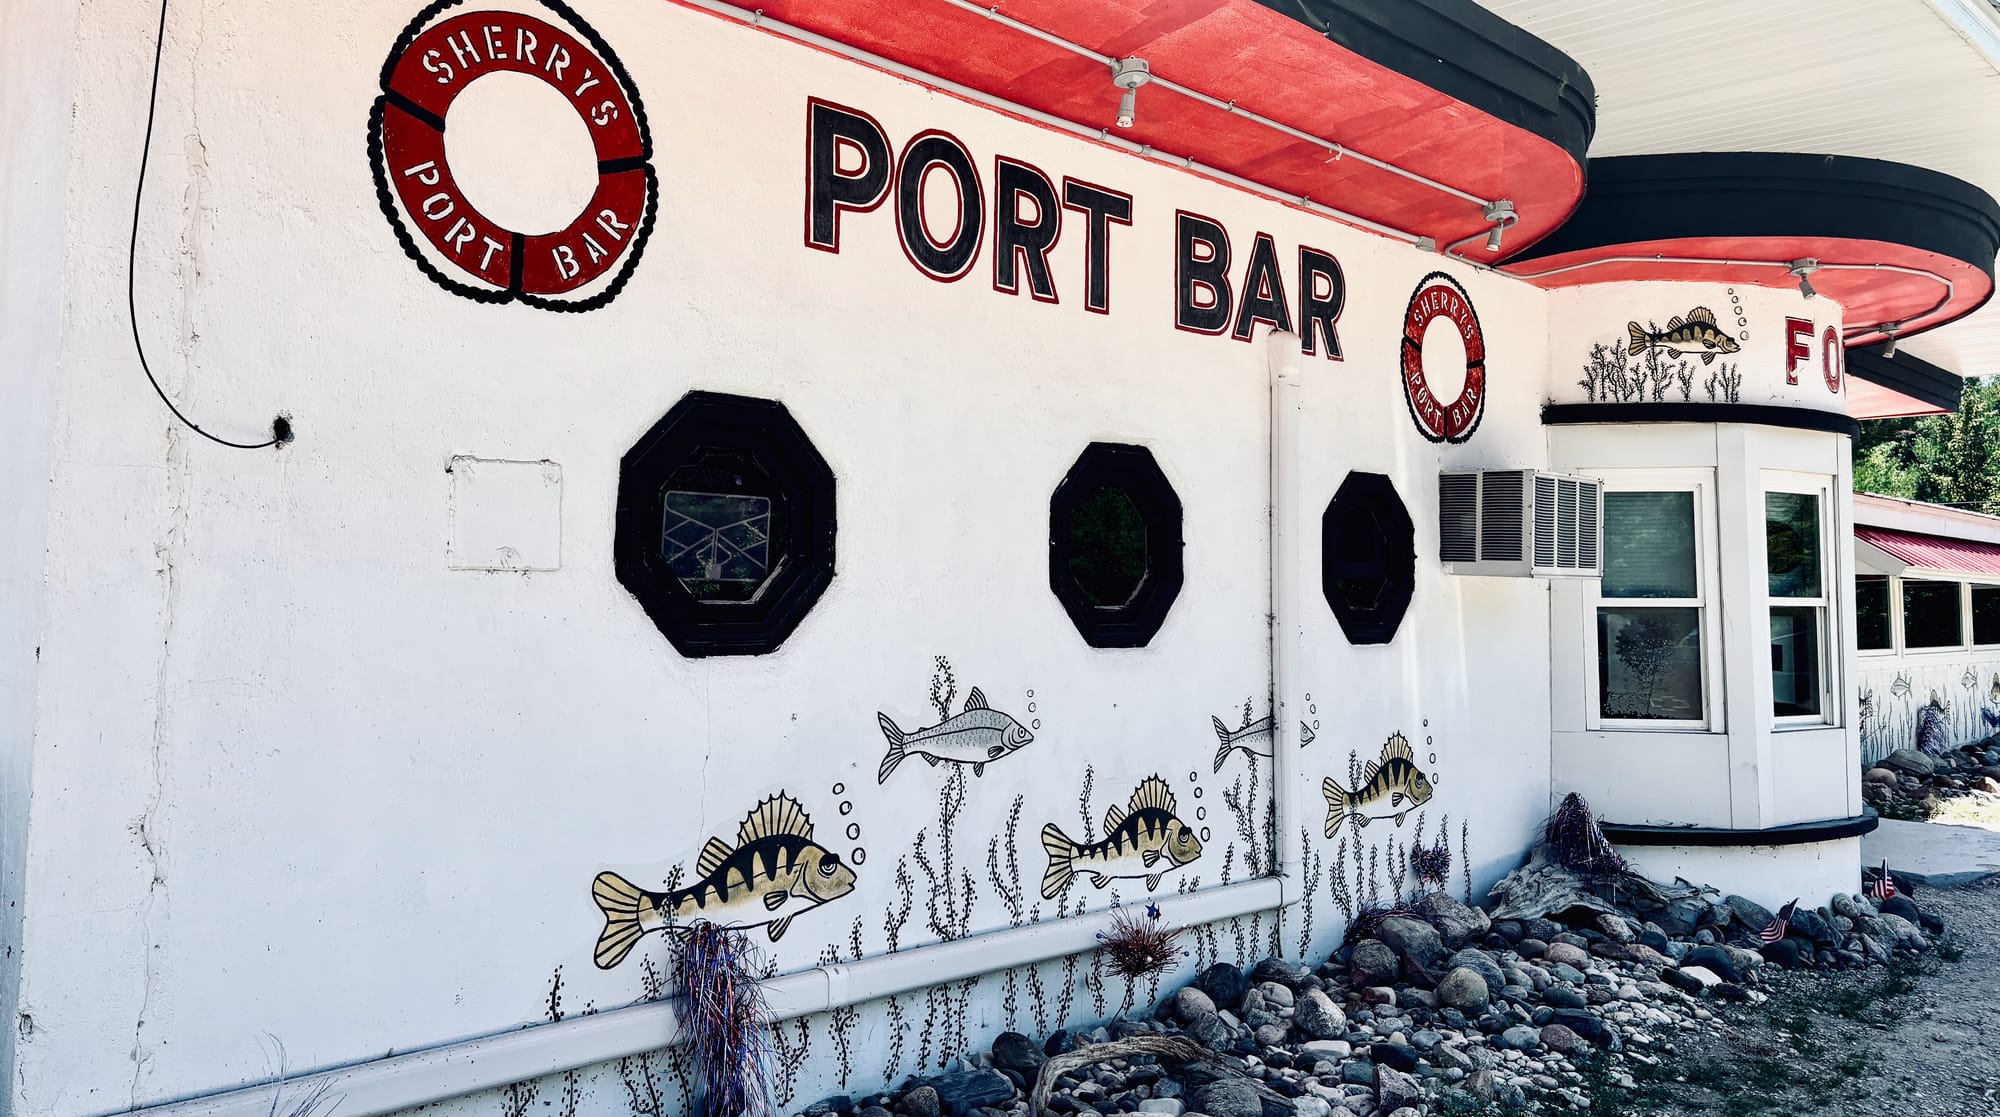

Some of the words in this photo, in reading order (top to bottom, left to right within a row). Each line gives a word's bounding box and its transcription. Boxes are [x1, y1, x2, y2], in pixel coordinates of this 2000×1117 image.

[422, 25, 619, 126] SHERRYS
[403, 160, 504, 272] PORT
[552, 208, 630, 281] BAR
[804, 95, 1133, 315] PORT
[1175, 209, 1346, 362] BAR
[1413, 291, 1475, 340] SHERRYS
[1785, 316, 1845, 394] FO
[1411, 371, 1441, 428] PORT
[1452, 387, 1478, 427] BAR
